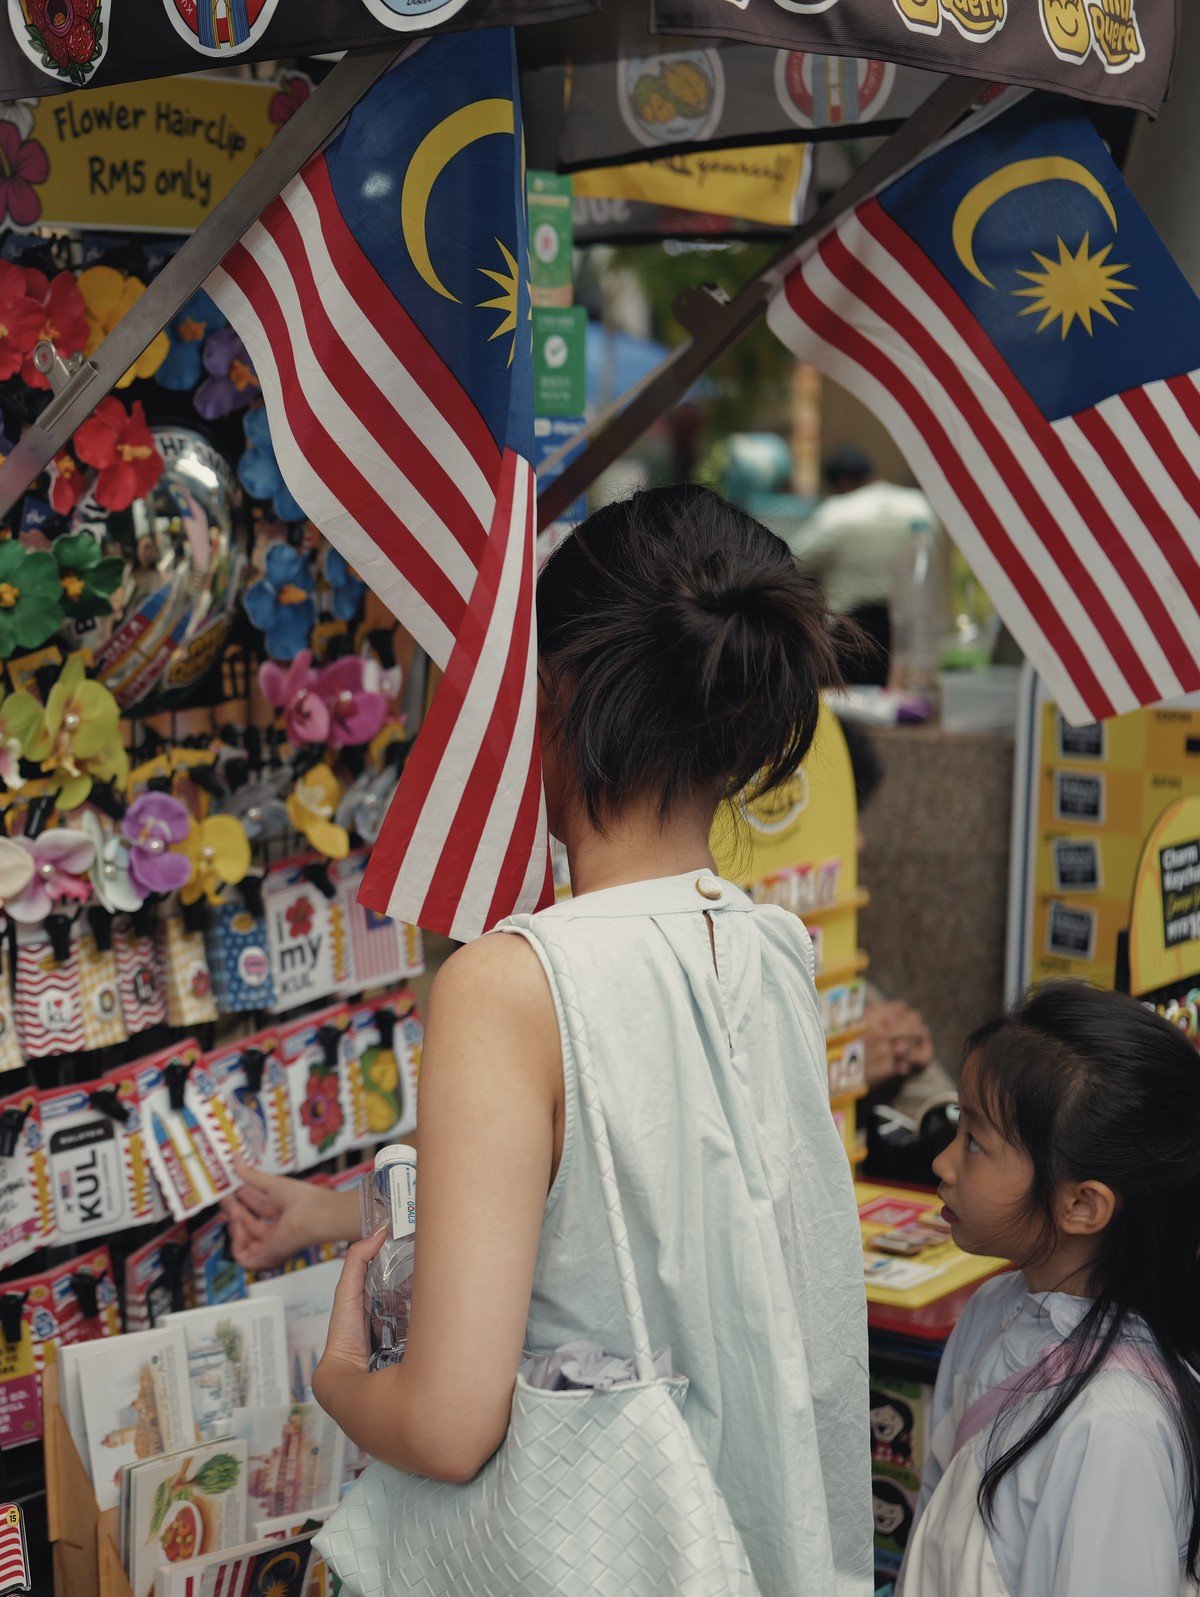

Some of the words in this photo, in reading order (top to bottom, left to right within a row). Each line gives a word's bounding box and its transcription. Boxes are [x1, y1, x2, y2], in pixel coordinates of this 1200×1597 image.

[54, 101, 147, 141] Flower
[156, 103, 246, 159] Hairclip
[88, 156, 146, 195] RM5
[156, 160, 211, 208] only
[281, 934, 323, 971] my
[75, 1149, 103, 1224] KUL
[406, 1200, 416, 1224] GOALS
[8, 1514, 17, 1523] 15
